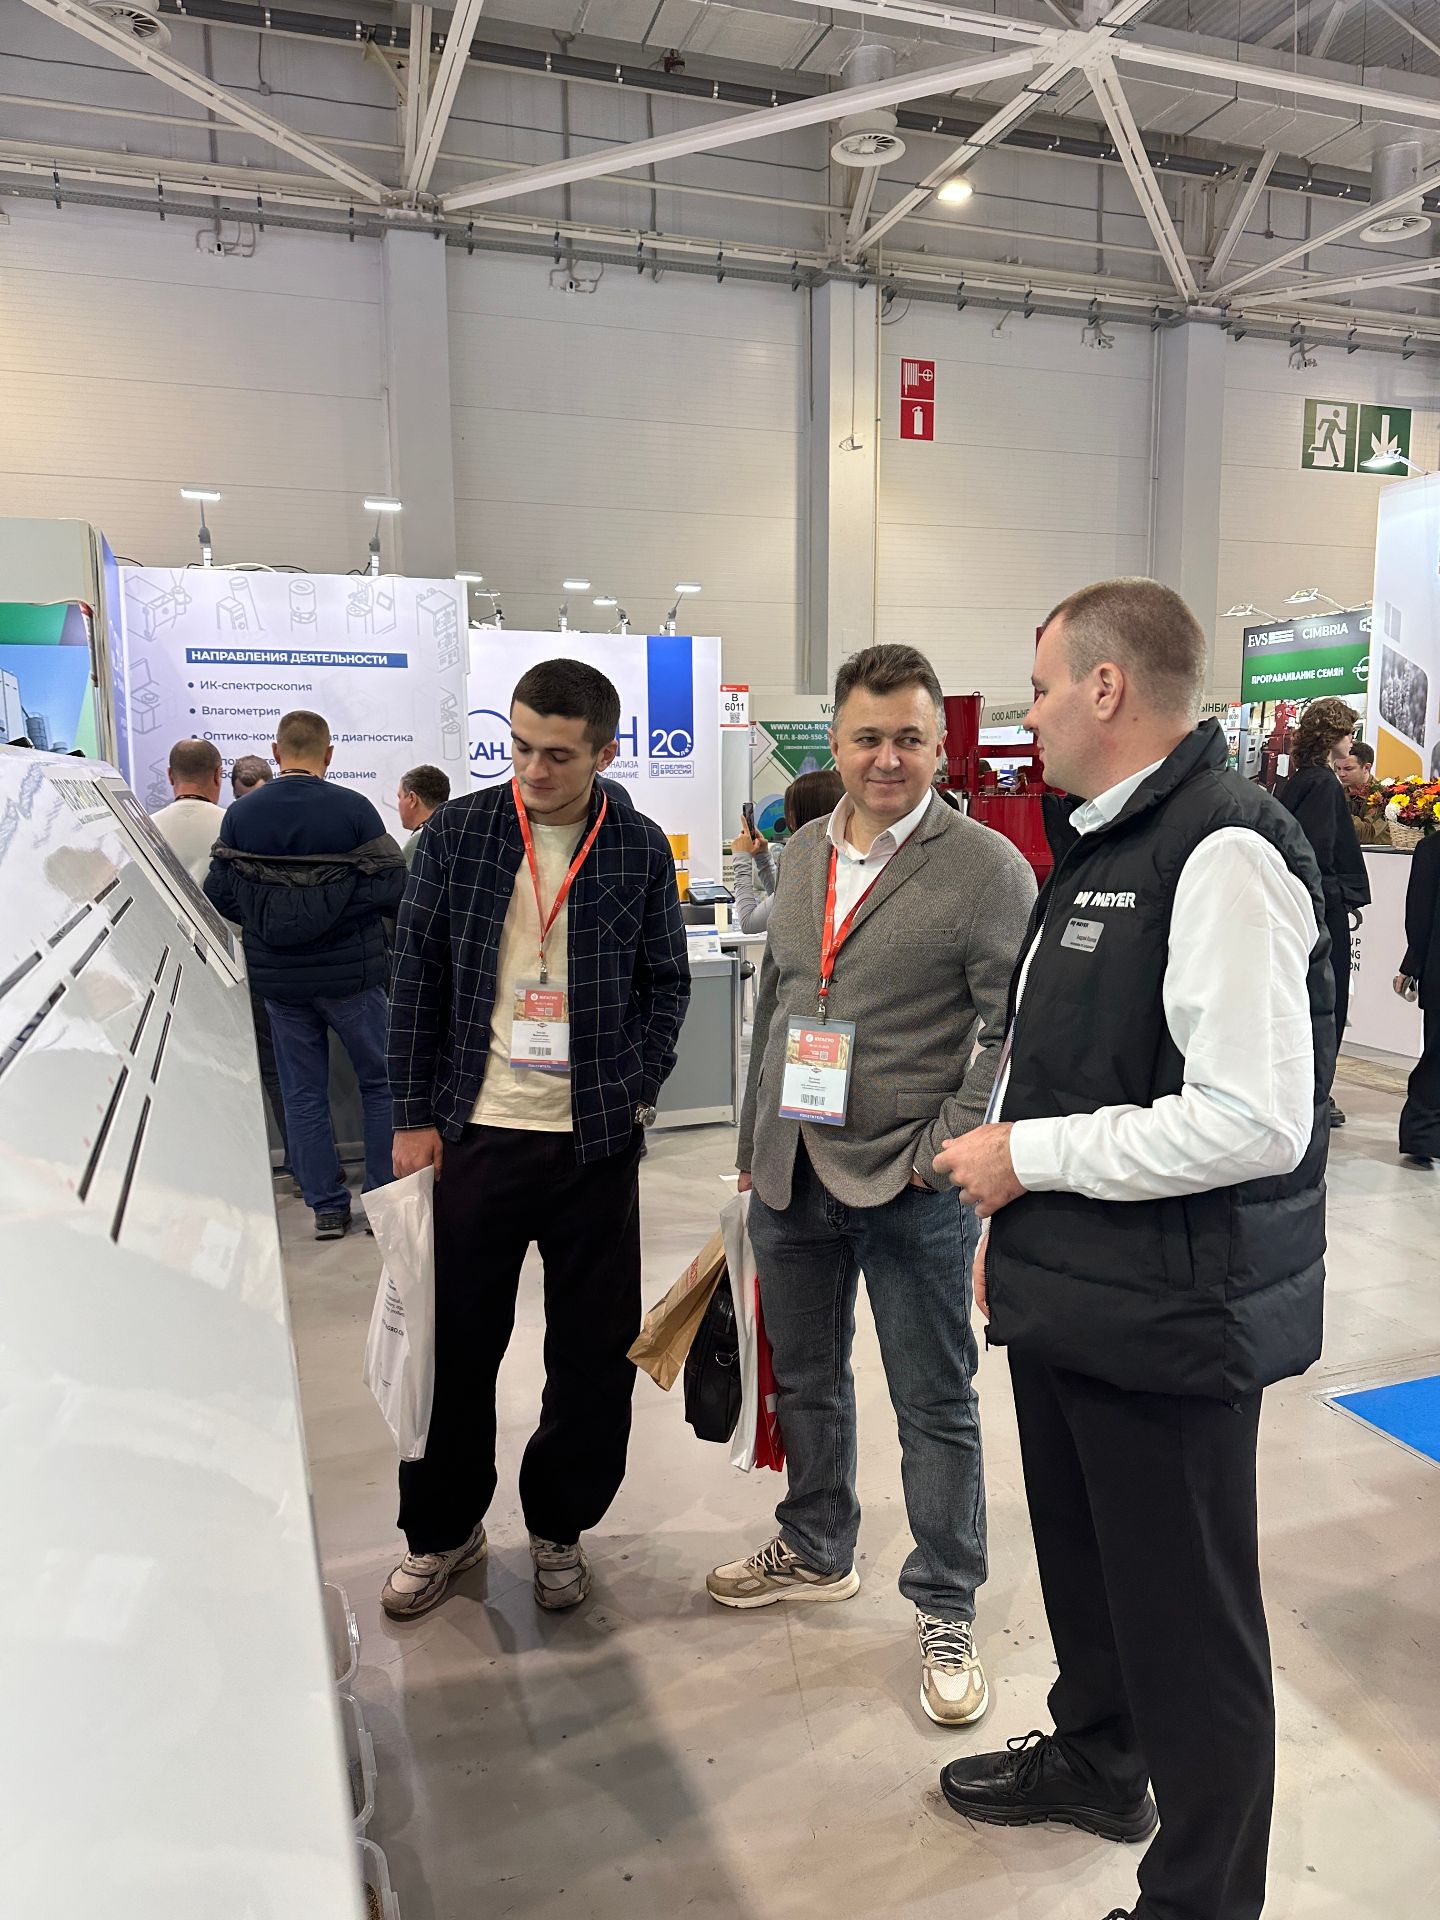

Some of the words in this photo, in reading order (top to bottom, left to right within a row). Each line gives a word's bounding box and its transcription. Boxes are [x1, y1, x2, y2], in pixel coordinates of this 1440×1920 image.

[1248, 631, 1268, 647] EVS
[1302, 622, 1349, 639] CIMBRIA
[191, 650, 287, 662] НАПРАВЛЕНИЯ
[290, 653, 388, 665] ДЕЯТЕЛЬНОСТИ
[1317, 666, 1344, 679] СЕМЯН
[200, 680, 313, 692] ИК-спектроскопия
[731, 694, 739, 702] B
[202, 706, 281, 718] Влагометрия
[725, 702, 744, 711] 6011
[991, 711, 1005, 721] ООО
[341, 734, 414, 743] диагностика
[651, 729, 691, 756] 20
[1090, 891, 1136, 908] MEYER
